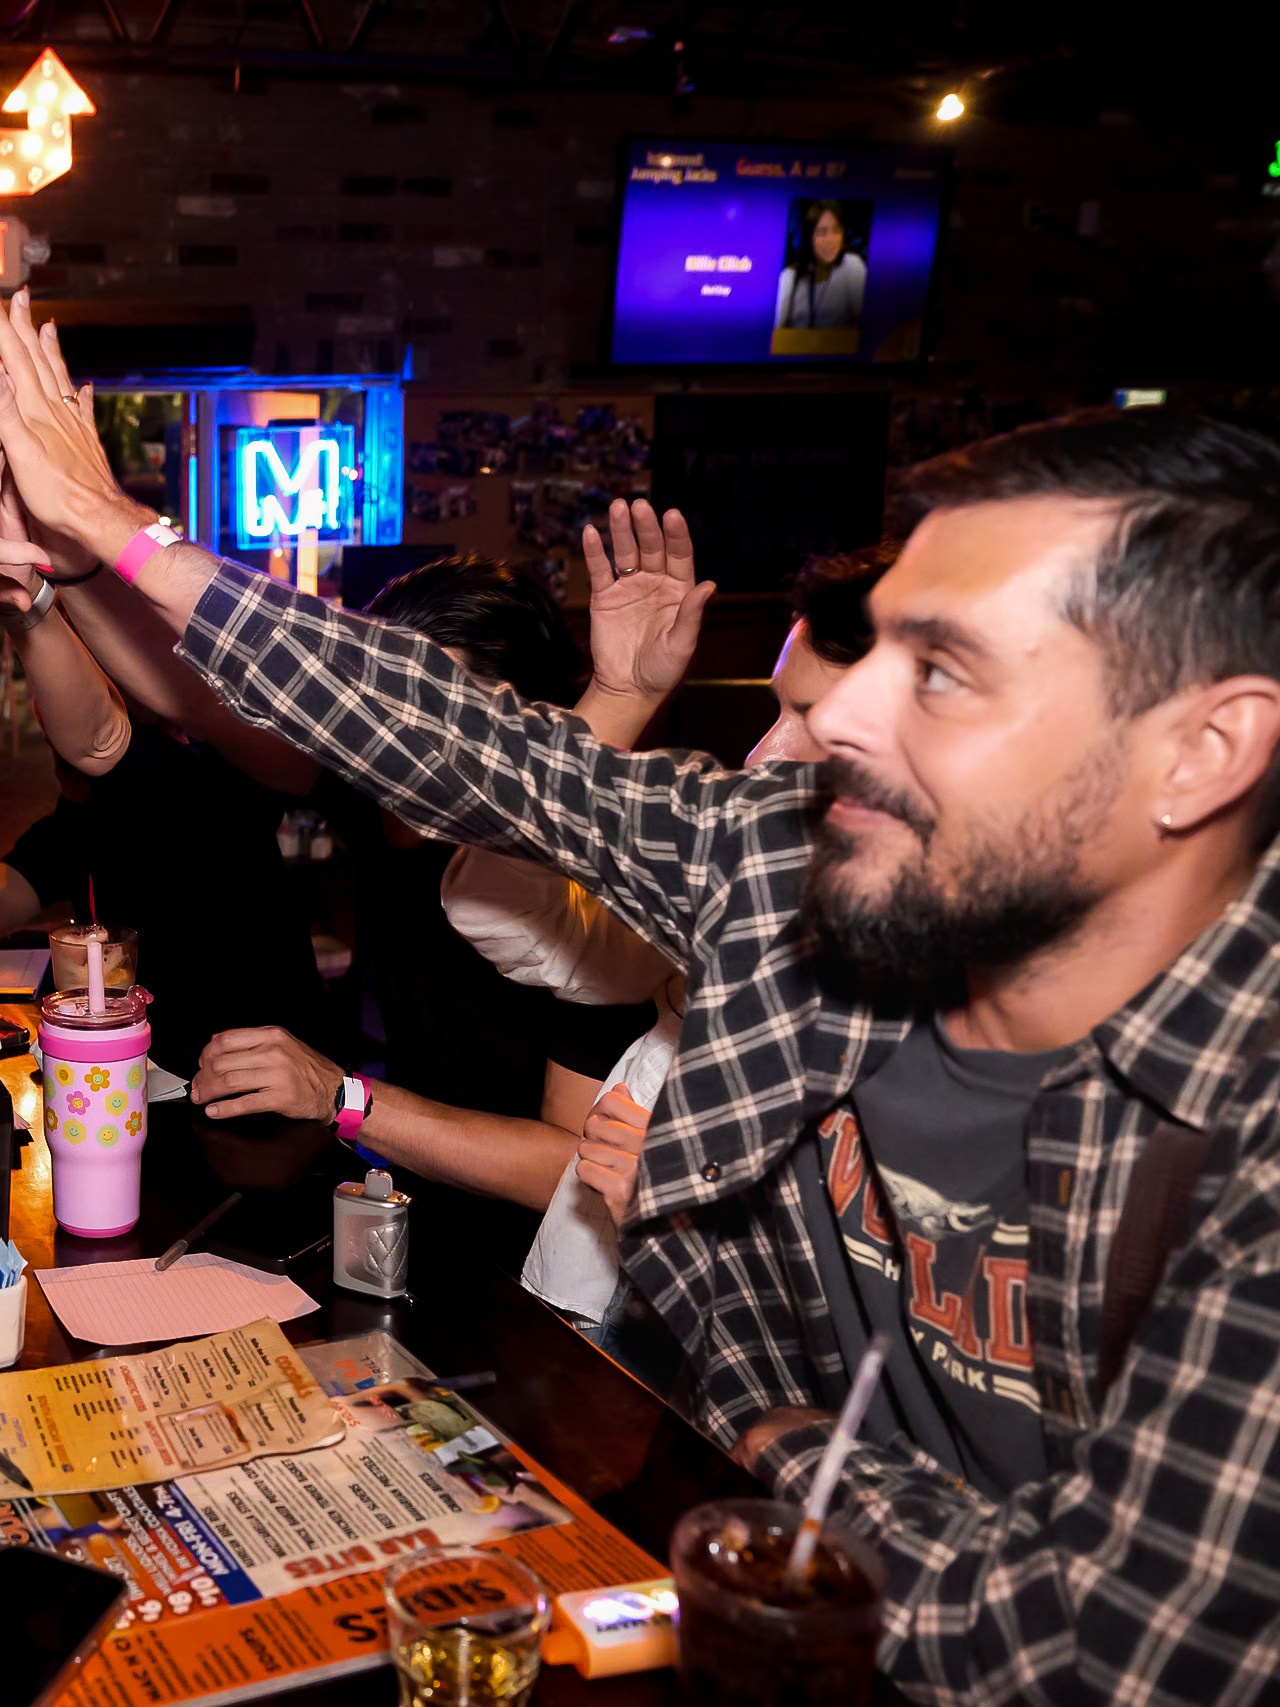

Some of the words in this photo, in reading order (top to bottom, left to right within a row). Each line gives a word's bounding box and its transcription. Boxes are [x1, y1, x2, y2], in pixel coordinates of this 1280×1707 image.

[179, 1520, 229, 1576] MON-FRI
[282, 1541, 374, 1579] BITES
[372, 1526, 441, 1557] BAR
